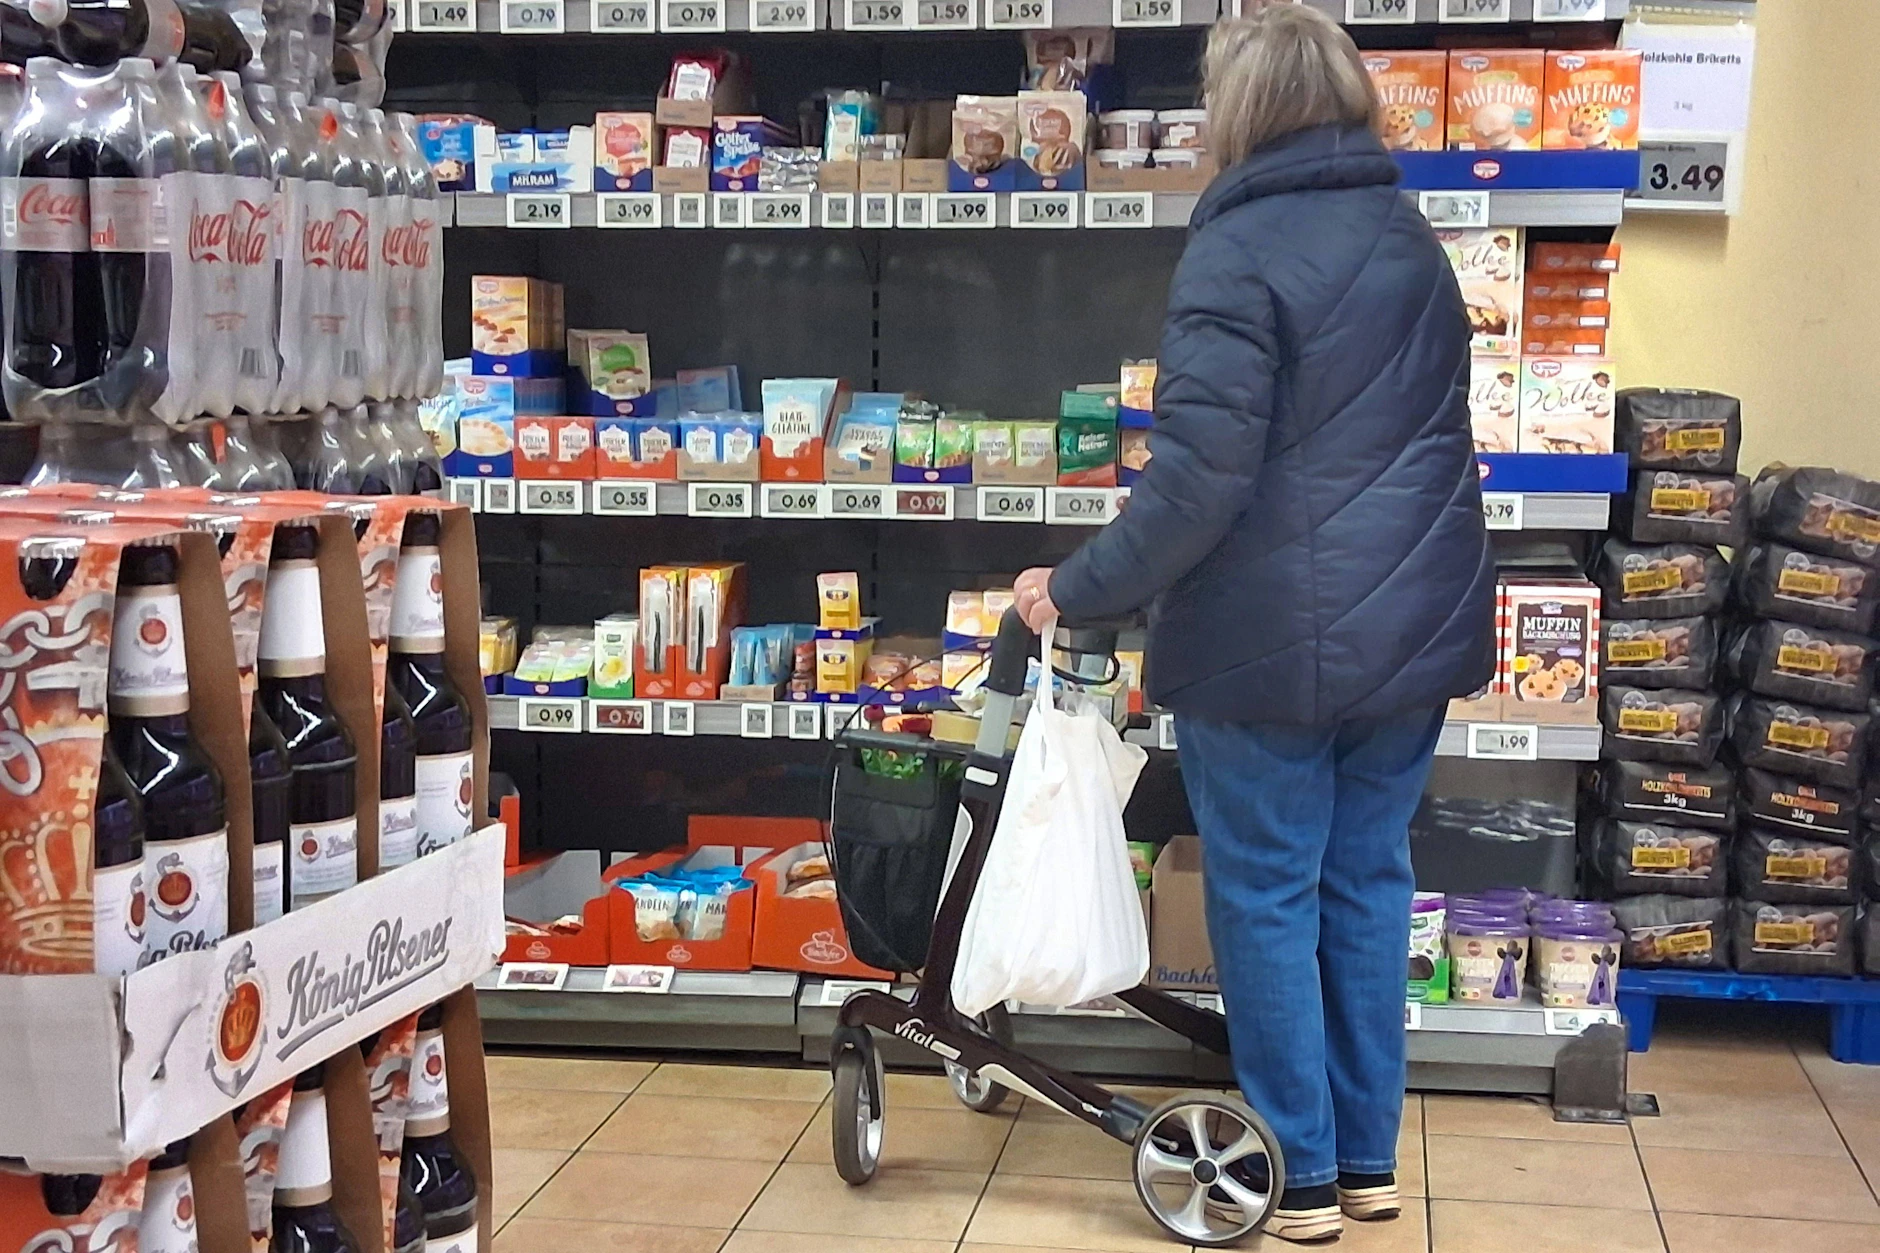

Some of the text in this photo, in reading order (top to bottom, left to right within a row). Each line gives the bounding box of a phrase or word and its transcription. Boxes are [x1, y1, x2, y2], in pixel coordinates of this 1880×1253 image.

[431, 7, 467, 21] 1.49
[521, 8, 556, 23] 0.79
[611, 8, 646, 22] 0.79
[681, 7, 716, 21] 0.79
[771, 6, 805, 21] 2.99
[865, 6, 902, 20] 1.59
[931, 4, 967, 19] 1.59
[1006, 4, 1042, 18] 1.59
[1134, 2, 1171, 16] 1.59
[1697, 53, 1741, 64] Briketts
[1453, 83, 1538, 115] MUFFINS
[1549, 84, 1635, 114] MUFFINS
[512, 174, 555, 186] MILRAM
[1650, 163, 1724, 191] 3.49
[527, 204, 561, 218] 2.19
[617, 204, 652, 217] 3.99
[766, 204, 801, 218] 2.99
[950, 204, 986, 218] 1.99
[1032, 204, 1068, 217] 1.99
[1107, 203, 1143, 217] 1.49
[540, 491, 574, 504] 0.55
[613, 492, 647, 505] 0.55
[709, 493, 743, 507] 0.35
[782, 494, 816, 508] 0.69
[845, 495, 880, 508] 0.69
[910, 496, 945, 509] 0.99
[999, 498, 1034, 511] 0.69
[1069, 500, 1105, 513] 0.79
[1484, 504, 1514, 518] 3.79
[1523, 617, 1581, 631] MUFFIN
[539, 709, 573, 722] 0.99
[609, 710, 643, 724] 0.79
[1499, 735, 1528, 748] 1.99
[277, 916, 452, 1039] König Pilsener
[894, 1018, 935, 1048] Vital
